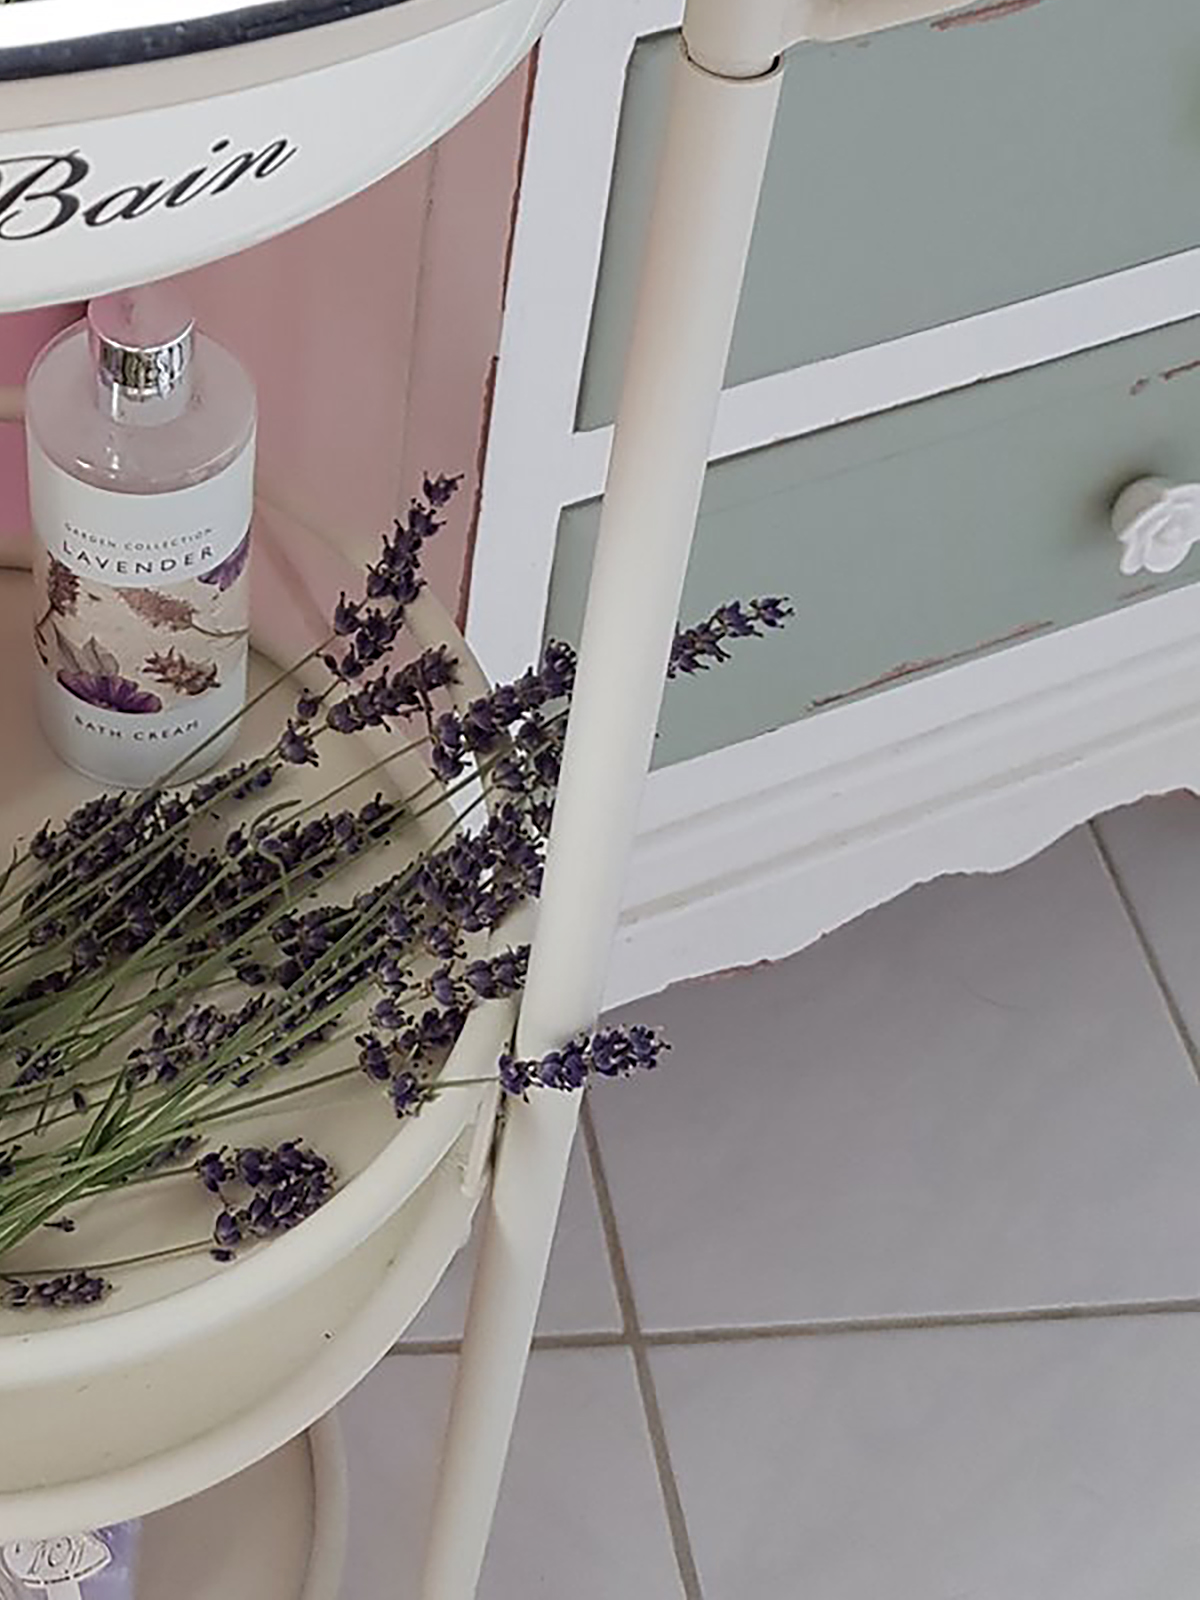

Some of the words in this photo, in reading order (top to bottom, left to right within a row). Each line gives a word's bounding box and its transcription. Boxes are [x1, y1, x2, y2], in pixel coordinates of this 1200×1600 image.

[124, 527, 212, 551] COLLECTION
[63, 540, 213, 574] LAVENDER
[74, 714, 122, 740] BATH
[133, 719, 199, 741] CREAM
